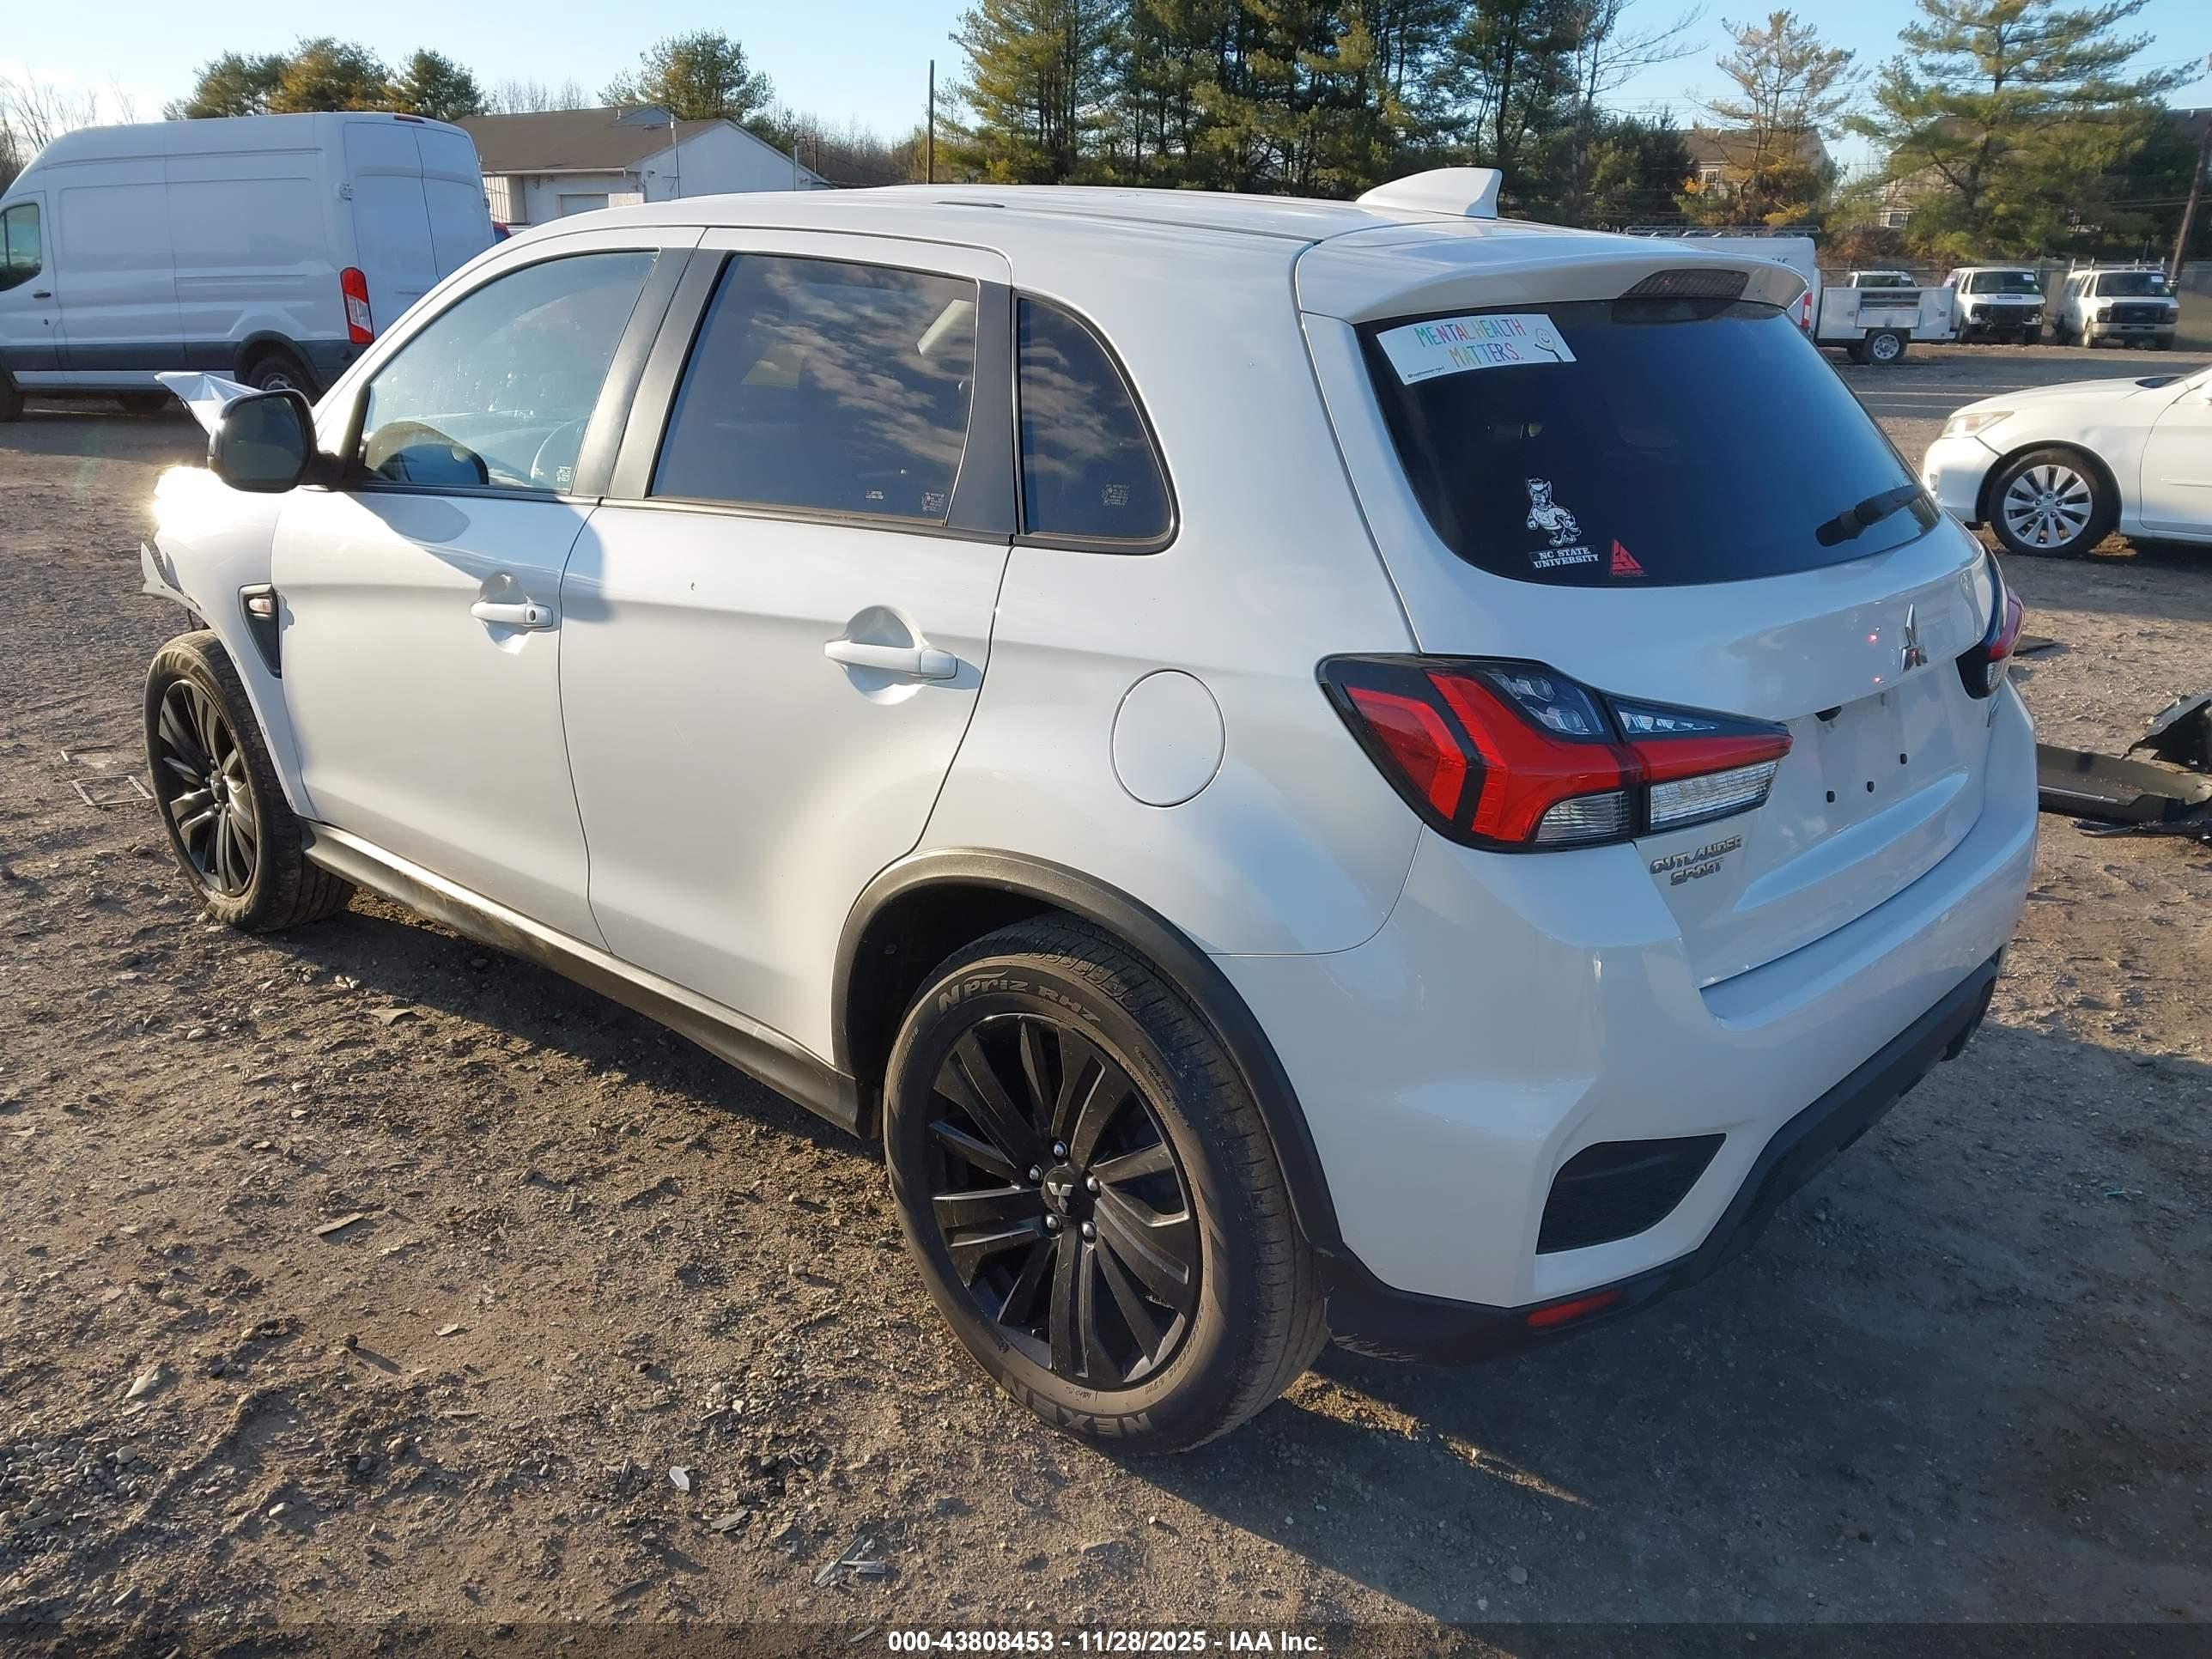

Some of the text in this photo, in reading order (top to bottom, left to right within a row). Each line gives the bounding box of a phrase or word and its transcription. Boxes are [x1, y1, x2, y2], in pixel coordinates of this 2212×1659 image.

[1414, 318, 1527, 348] MENTAL HEALTH
[1449, 342, 1524, 368] MATTERS.
[1534, 553, 1600, 569] UNIVERSITY
[1539, 547, 1591, 560] NC STATE
[1650, 835, 1744, 874] OUTLANDER
[1670, 858, 1725, 886] SPORT
[1001, 1368, 1156, 1437] NEXEN
